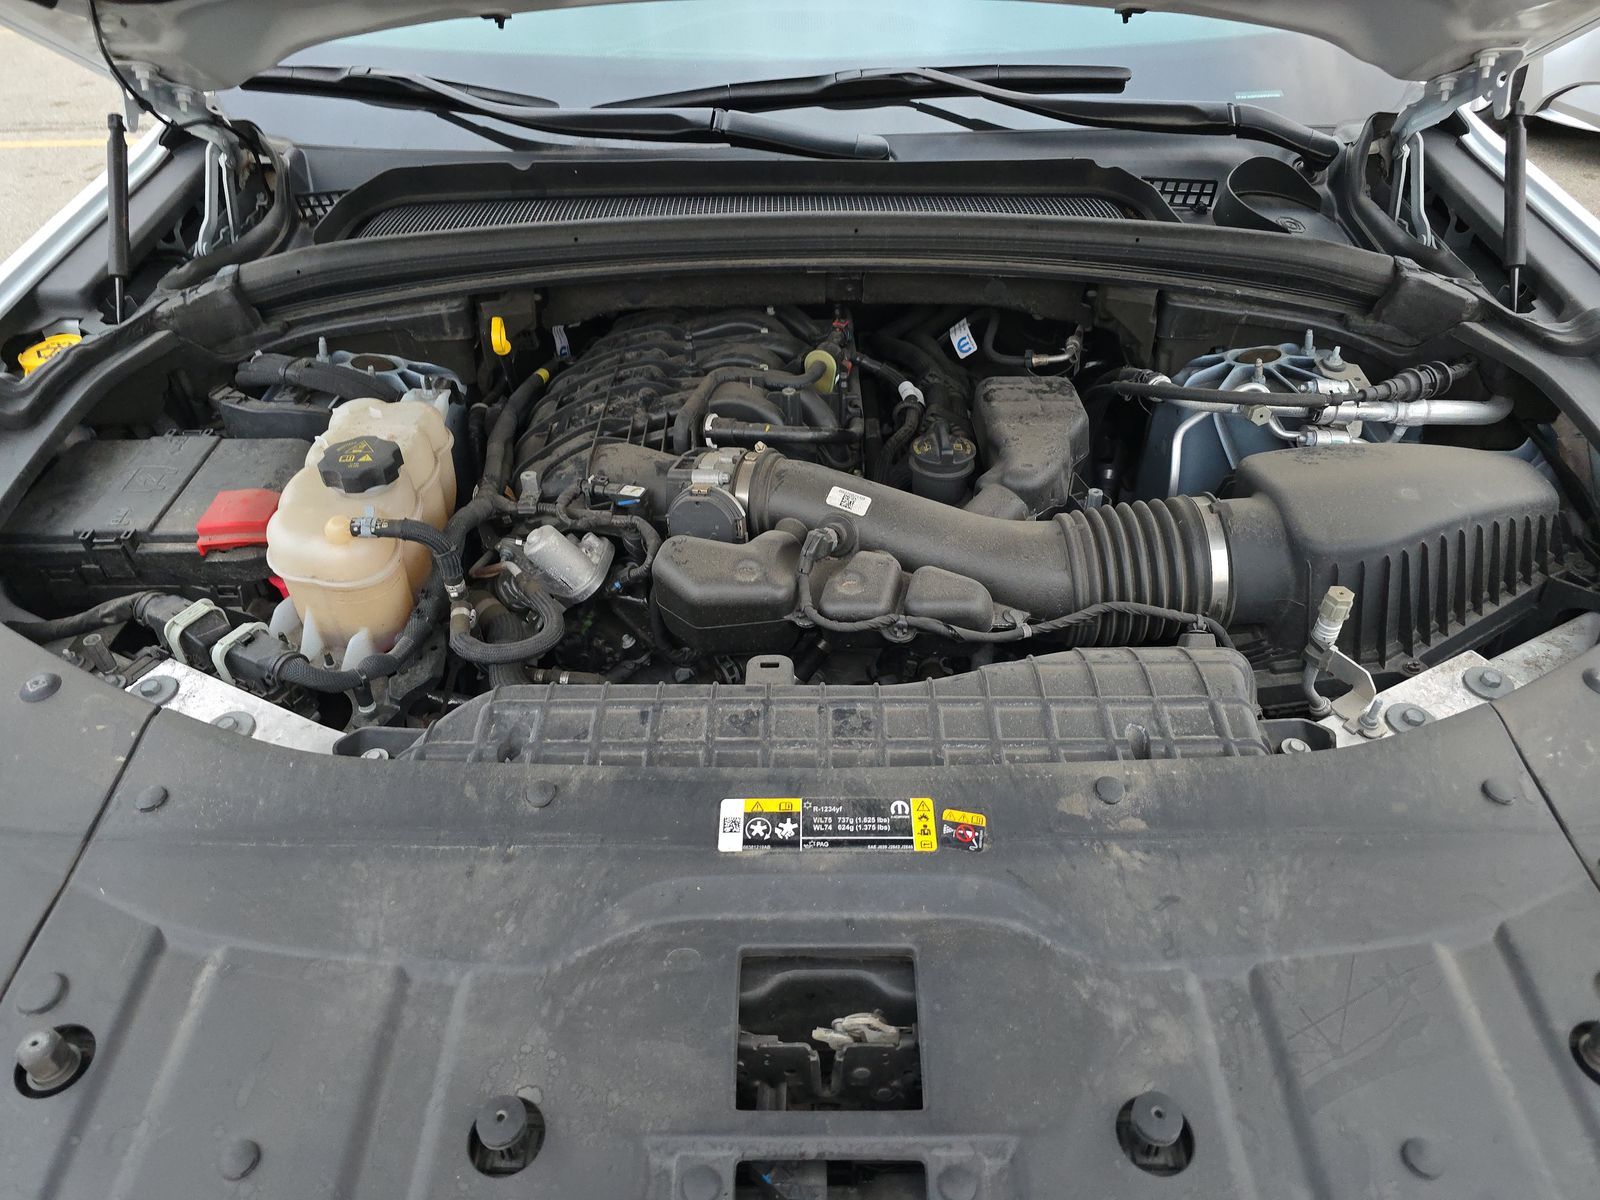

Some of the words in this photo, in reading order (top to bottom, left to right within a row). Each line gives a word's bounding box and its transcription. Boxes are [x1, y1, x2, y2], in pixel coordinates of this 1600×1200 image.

[812, 805, 843, 814] R-1234yf
[837, 816, 854, 825] 737g
[837, 824, 854, 832] 624g
